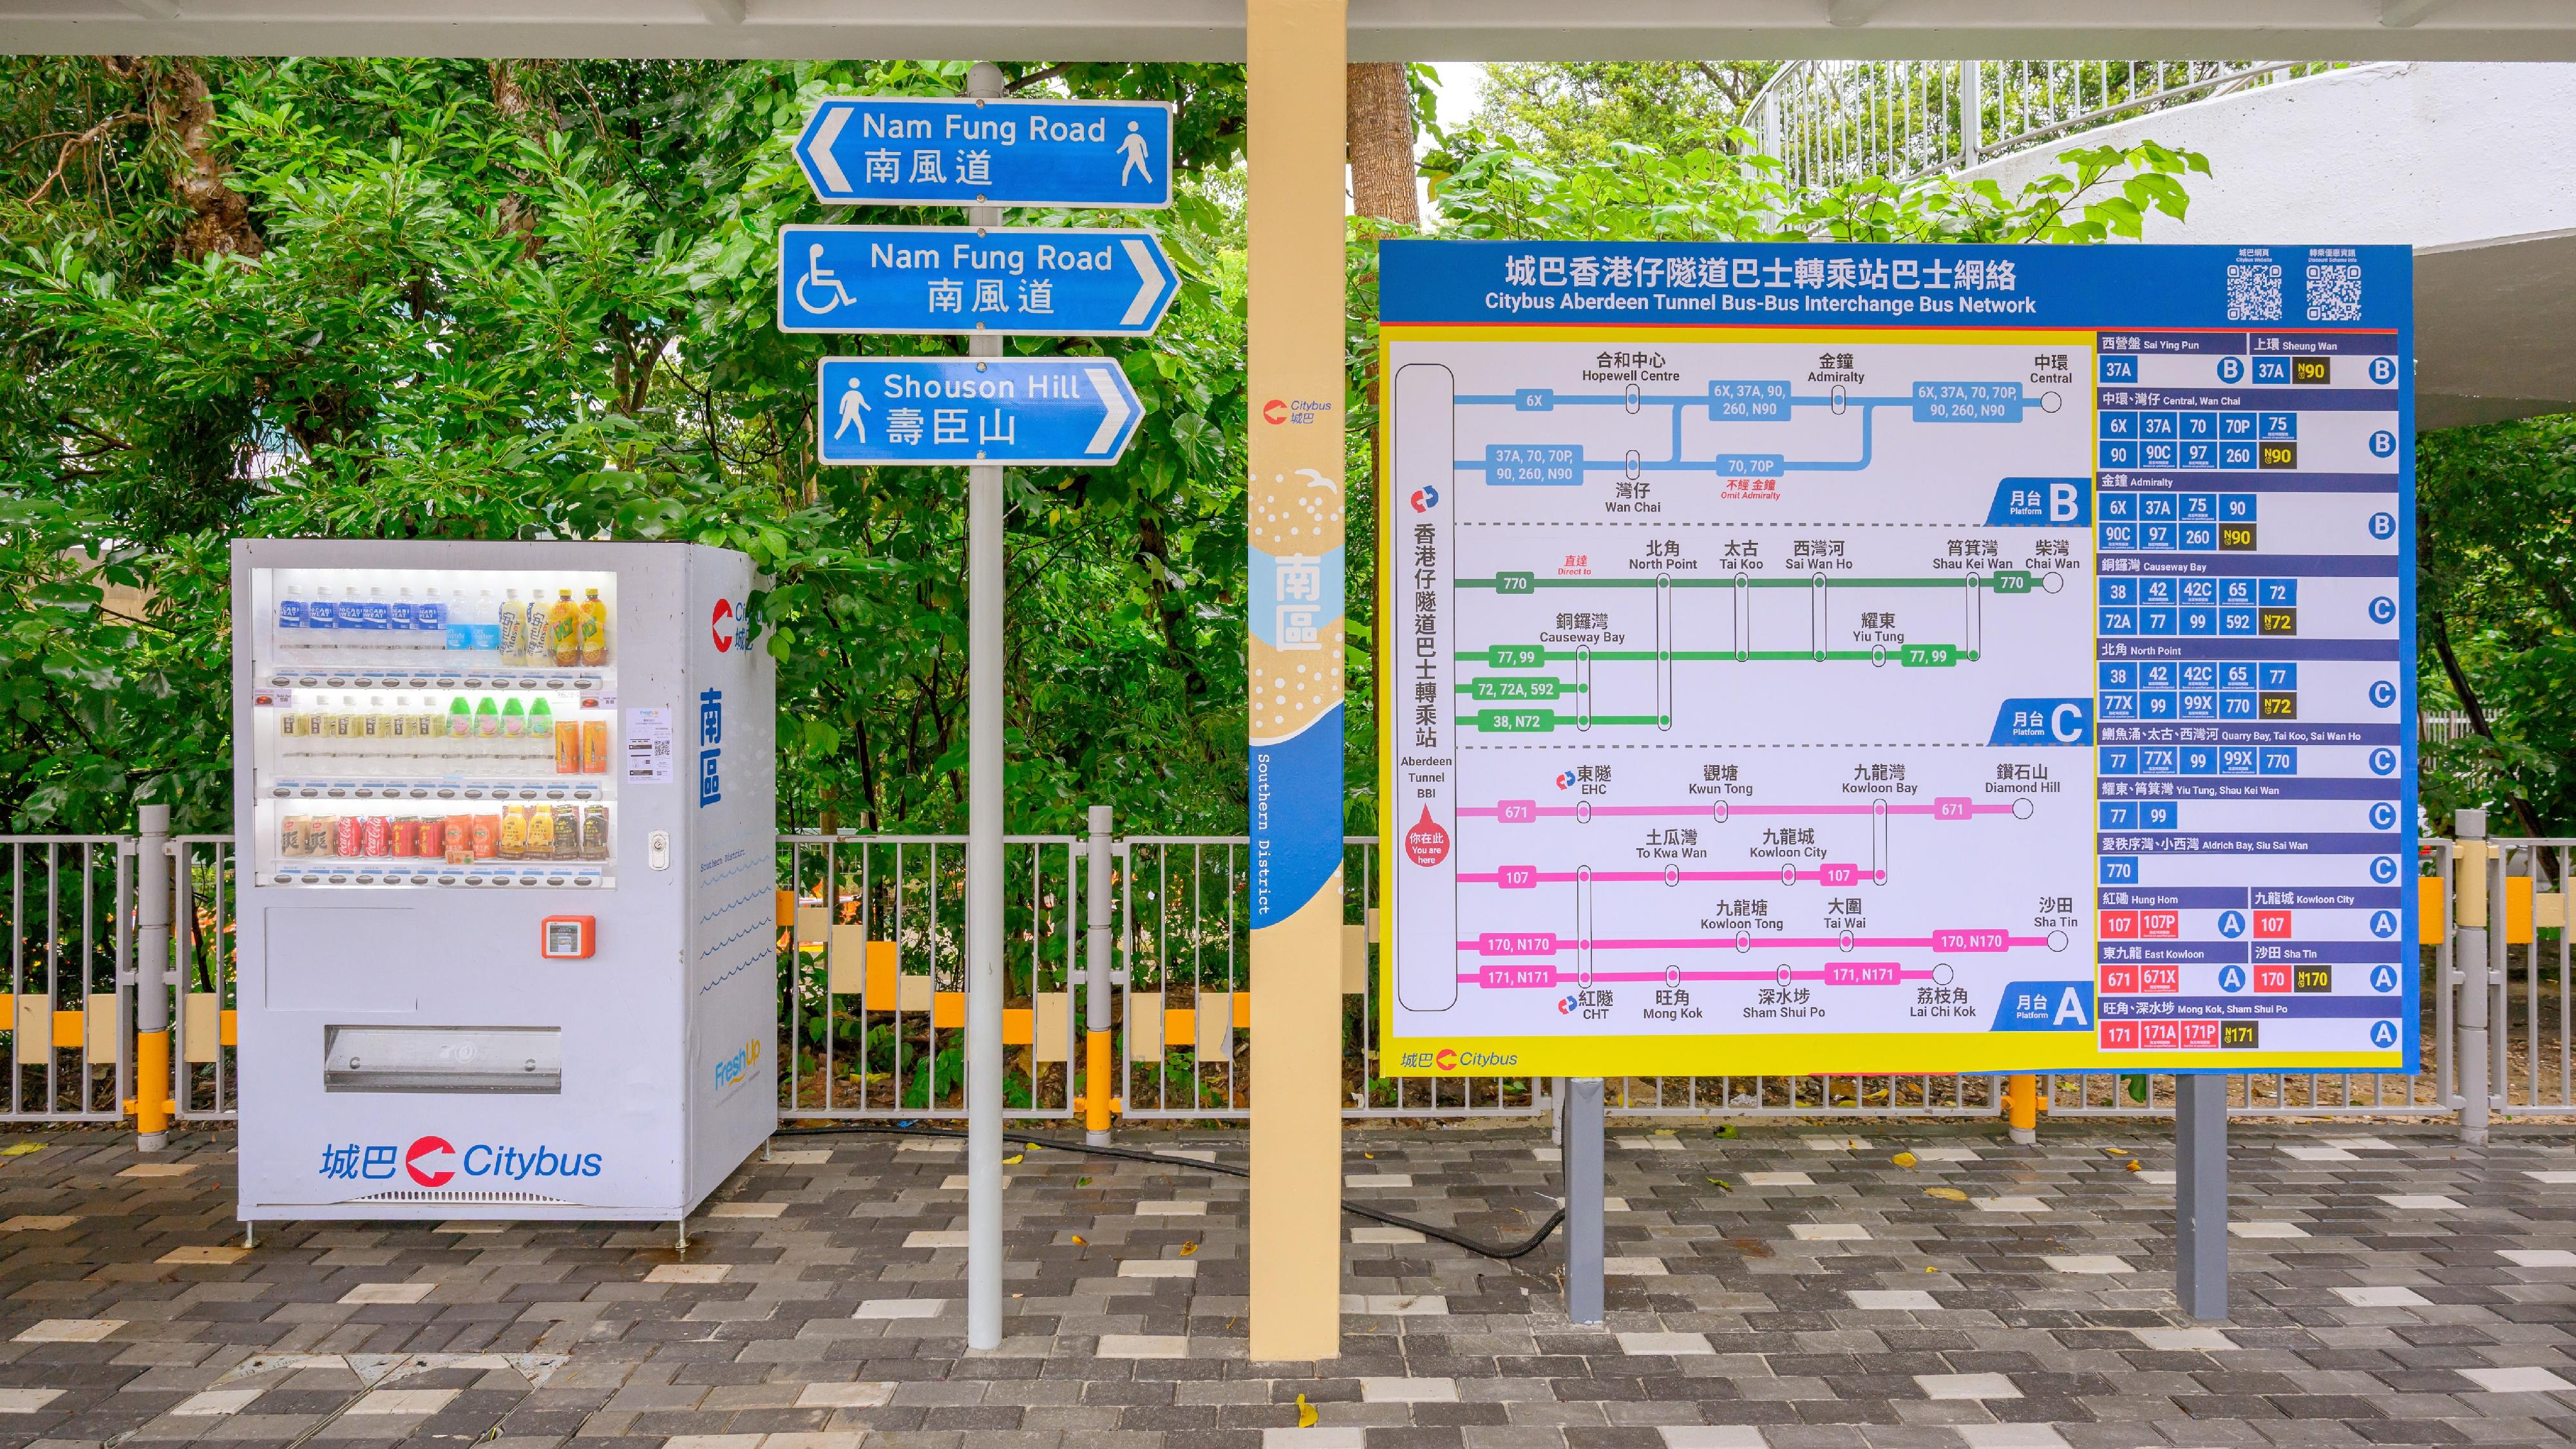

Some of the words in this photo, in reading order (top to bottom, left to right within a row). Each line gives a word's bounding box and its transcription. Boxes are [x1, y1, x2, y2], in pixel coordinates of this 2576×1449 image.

[864, 113, 931, 138] Nam
[947, 115, 1015, 146] Fung
[1030, 116, 1104, 142] Road
[865, 147, 992, 185] 南風道
[872, 243, 939, 269] Nam
[954, 245, 1023, 275] Fung
[1038, 245, 1111, 270] Road
[1506, 255, 2016, 290] 城巴香港仔隧道巴士轉乘站巴士網絡
[928, 278, 1054, 313] 南風道
[1486, 292, 1555, 313] Citybus
[1560, 292, 1648, 309] Aberdeen
[1653, 294, 1715, 310] Tunnel
[1723, 295, 1799, 310] Bus-Bus
[1806, 295, 1913, 316] Interchange
[1920, 296, 1953, 312] Bus
[1960, 296, 2036, 312] Network
[2102, 336, 2141, 350] 西營盤
[2160, 341, 2179, 350] Ying
[2254, 338, 2279, 350] 上環
[2283, 341, 2316, 352] Sheung
[1597, 352, 1665, 368] 合和中心
[1819, 353, 1853, 369] 金鐘
[2035, 354, 2067, 370] 中環
[2107, 363, 2131, 376] 37A
[2224, 360, 2237, 377] B
[2259, 364, 2284, 377] 37A
[1583, 370, 1636, 383] Hopewell
[1641, 371, 1679, 381] Centre
[1808, 372, 1864, 384] Admiralty
[2031, 373, 2072, 383] Central
[884, 374, 1014, 399] Shouson
[1029, 375, 1079, 399] Hill
[1714, 386, 1733, 399] 6X,
[1737, 386, 1763, 399] 37A,
[1768, 386, 1785, 399] 90,
[1527, 395, 1542, 406] 6X
[2103, 392, 2160, 405] 中環、灣仔
[2163, 397, 2197, 406] Central,
[1291, 401, 1331, 411] Citybus
[1291, 413, 1314, 424] 城巴
[886, 408, 1014, 445] 壽臣山
[1497, 450, 1522, 464] 37A,
[1527, 450, 1545, 464] 70,
[1549, 450, 1572, 464] 70P,
[1497, 468, 1514, 482] 90,
[1519, 468, 1544, 482] 260,
[1548, 468, 1572, 479] N90
[1616, 482, 1650, 498] 灣仔
[1727, 479, 1750, 490] 不經
[1752, 479, 1776, 490] 金鐘
[1742, 492, 1780, 500] Admiralty
[2011, 491, 2041, 506] 月台
[2050, 484, 2078, 521] B
[1605, 502, 1630, 512] Wan
[1634, 502, 1660, 512] Chai
[1947, 540, 1998, 556] 筲箕灣
[1564, 555, 1587, 566] 直達
[1933, 558, 1962, 569] Shau
[1967, 558, 1984, 569] Kei
[1988, 559, 2012, 569] Wan
[1504, 578, 1526, 589] 770
[1275, 553, 1321, 652] 南區
[1557, 613, 1607, 630] 銅鑼灣
[1414, 524, 1436, 747] 香港仔隧道巴士轉乘站
[1540, 632, 1600, 645] Causeway
[1604, 632, 1625, 645] Bay
[1498, 651, 1516, 665] 77,
[1520, 652, 1535, 663] 99
[2184, 667, 2211, 680] 42C
[2185, 696, 2211, 709] 99X
[2222, 732, 2251, 741] Quarry
[2254, 732, 2271, 741] Bay,
[2273, 732, 2286, 740] Tai
[2289, 732, 2308, 741] Koo,
[700, 687, 721, 808] 南區
[1401, 757, 1452, 766] Aberdeen
[1408, 773, 1444, 782] Tunnel
[1577, 765, 1611, 782] 東隧
[1997, 764, 2047, 780] 鑽石山
[1258, 755, 1270, 829] Southern
[1417, 789, 1435, 798] BBI
[1582, 784, 1606, 794] EHC
[1986, 782, 2036, 792] Diamond
[2041, 782, 2060, 792] Hill
[1506, 806, 1526, 818] 671
[1410, 833, 1443, 844] 你在此
[2236, 842, 2253, 851] Bay,
[701, 858, 723, 872] Southern
[1418, 855, 1436, 864] here
[1259, 840, 1271, 914] District
[2103, 892, 2128, 904] 紅磡
[2132, 896, 2155, 905] Hung
[2145, 915, 2175, 928] 107P
[2145, 970, 2175, 983] 671X
[1759, 988, 1810, 1005] 深水埗
[1743, 1007, 1776, 1018] Sham
[1781, 1007, 1806, 1017] Shui
[1811, 1007, 1825, 1017] Po
[2053, 987, 2087, 1025] A
[2184, 1025, 2215, 1038] 171P
[715, 1037, 761, 1092] FreshUp
[1401, 1053, 1433, 1067] 城巴
[1460, 1052, 1517, 1067] Citybus
[319, 1144, 397, 1179] 城巴
[464, 1145, 601, 1180] Citybus
